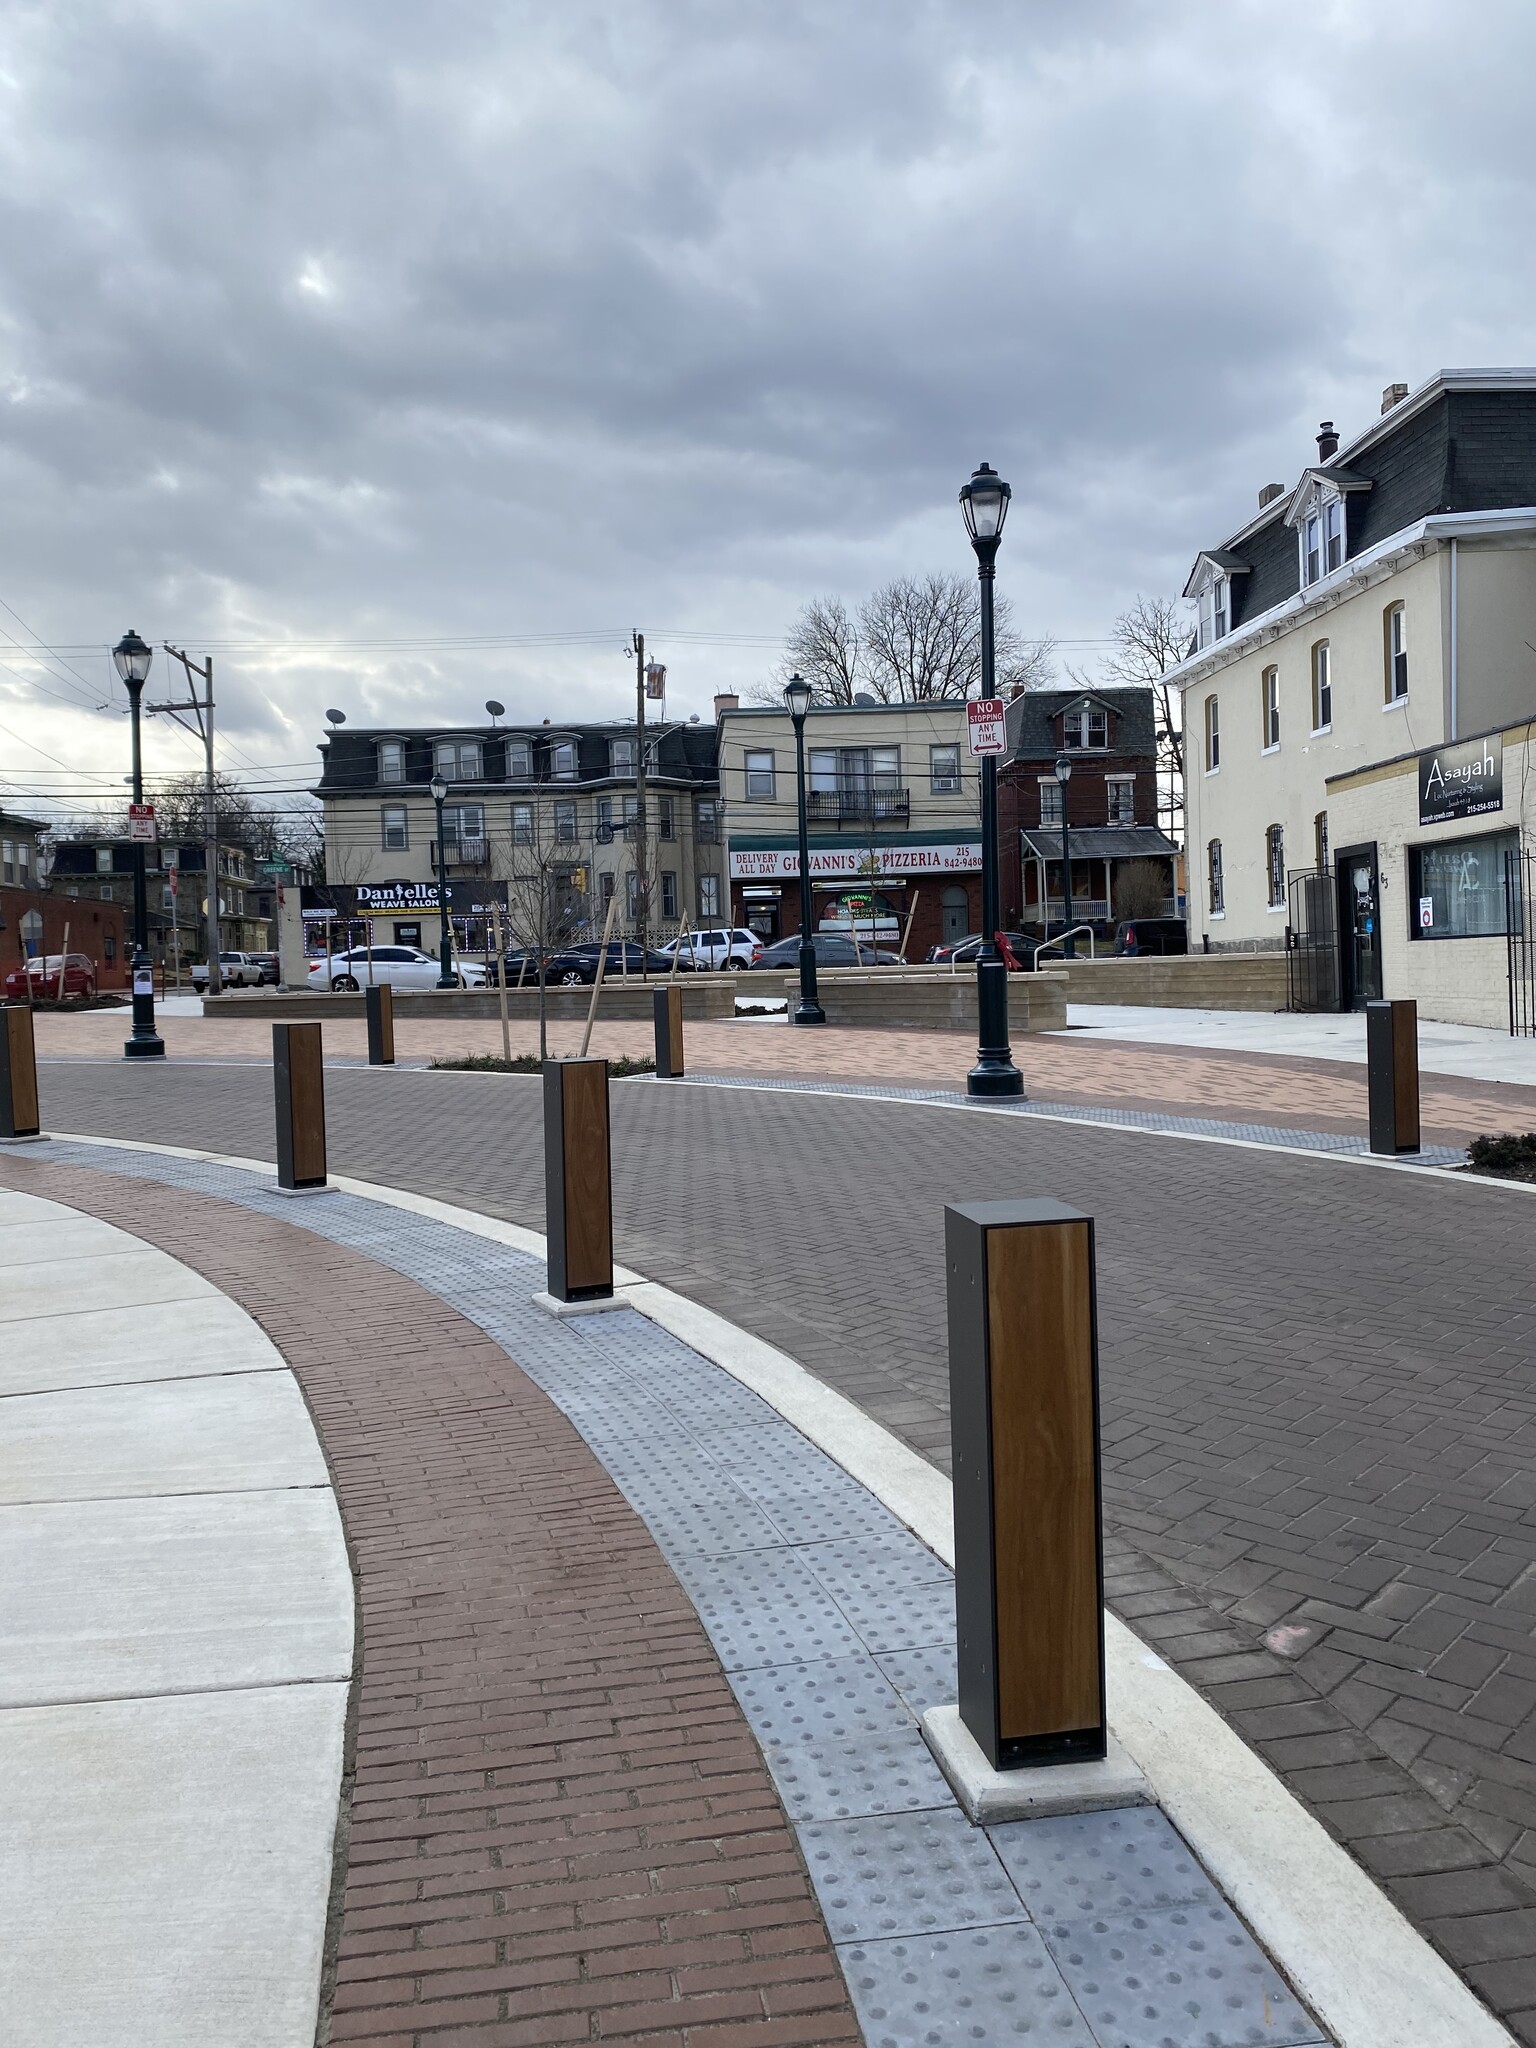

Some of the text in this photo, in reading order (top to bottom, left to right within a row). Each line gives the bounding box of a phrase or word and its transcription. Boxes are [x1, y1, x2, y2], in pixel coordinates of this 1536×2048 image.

[976, 702, 994, 714] NO
[969, 713, 1003, 723] STOPPING
[978, 723, 995, 733] ANY
[977, 733, 997, 743] TIME
[1424, 738, 1495, 800] Asayah
[135, 806, 148, 814] NO
[1466, 799, 1501, 814] 215-254-5518
[956, 847, 970, 857] 215
[736, 853, 779, 864] DELIVERY
[882, 852, 941, 868] PIZZERIA
[944, 857, 982, 868] 842-9480
[739, 864, 776, 874] ALL DAY
[370, 900, 440, 909] WEAVE SALON
